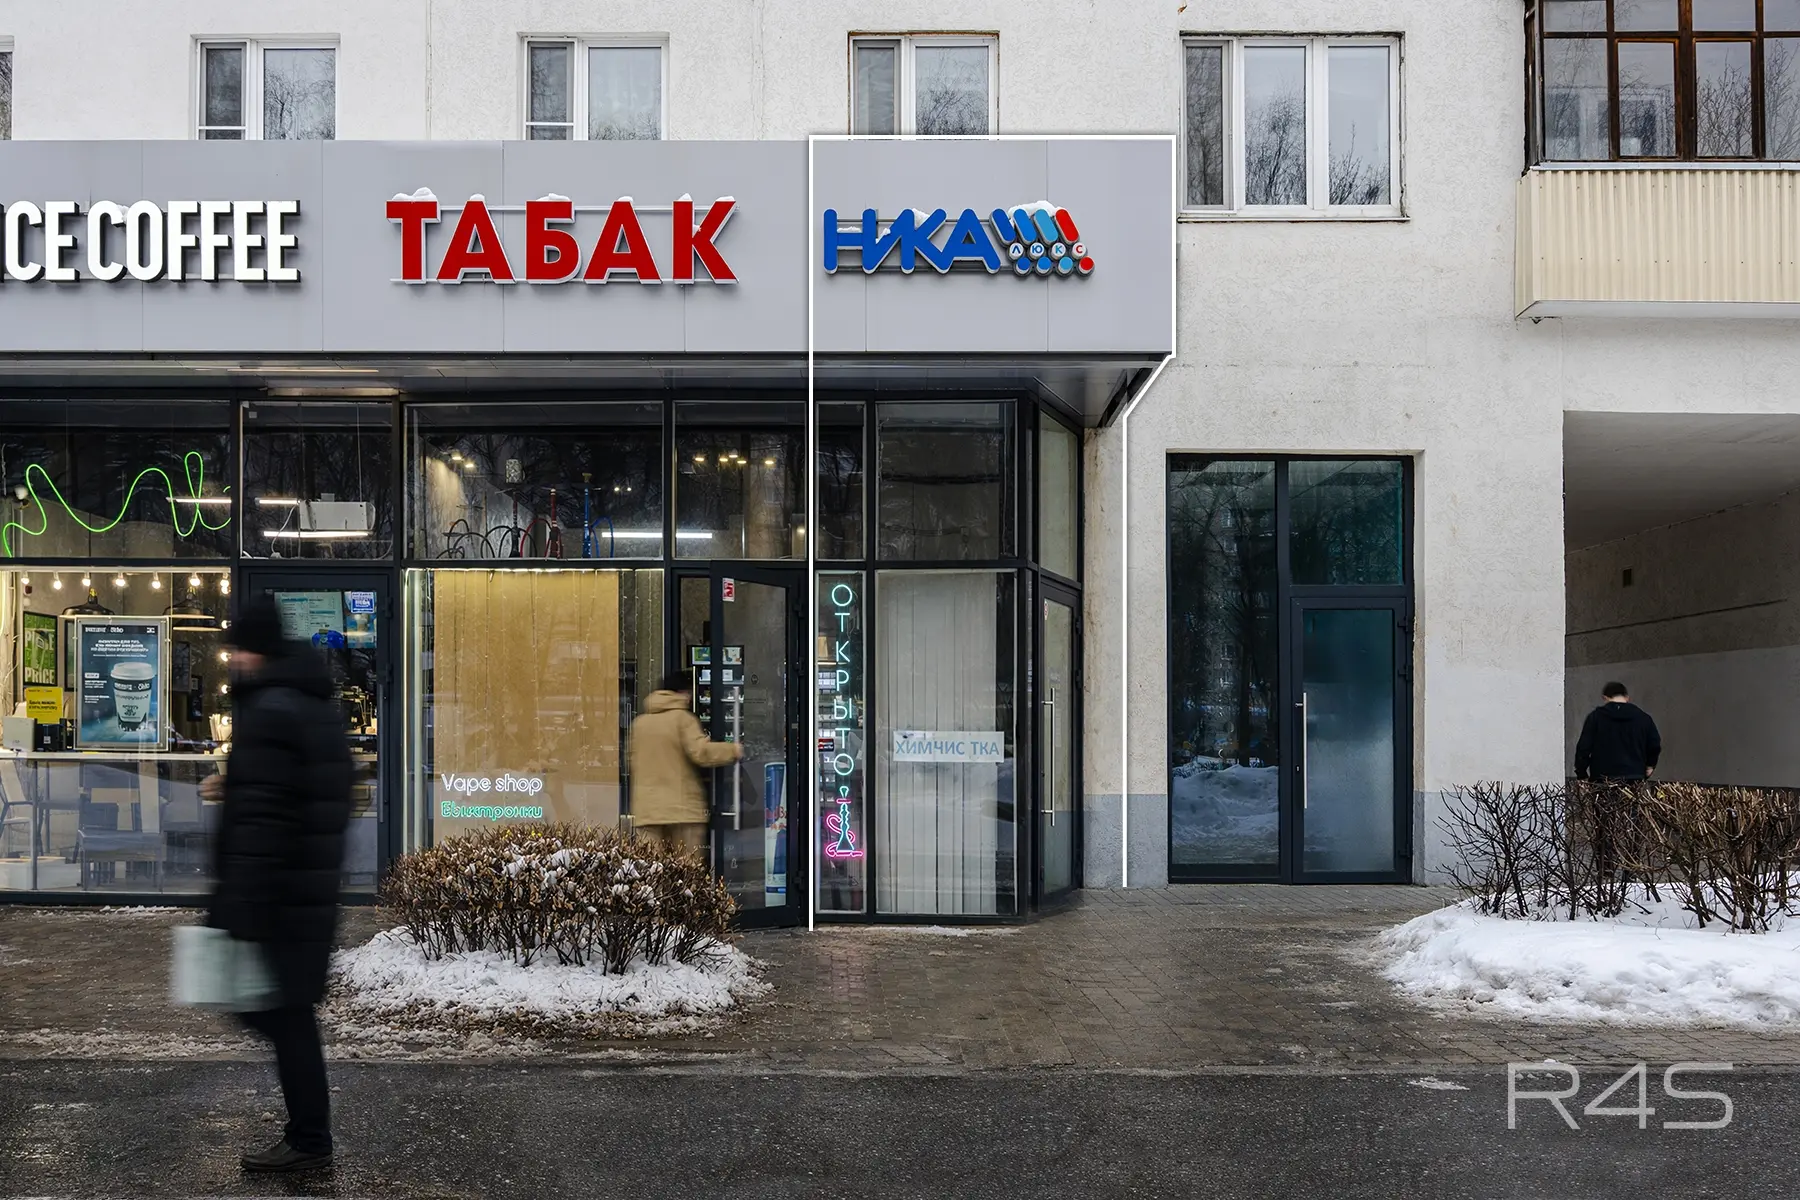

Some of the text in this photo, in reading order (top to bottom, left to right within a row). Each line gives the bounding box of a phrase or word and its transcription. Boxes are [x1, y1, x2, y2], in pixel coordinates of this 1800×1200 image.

[0, 200, 300, 282] CE COFFEE
[386, 199, 737, 284] ТАБАК
[823, 207, 1002, 274] НИКА
[24, 667, 55, 684] PRICE
[831, 583, 855, 776] ОТКРЫТО
[441, 773, 543, 796] Vape shop
